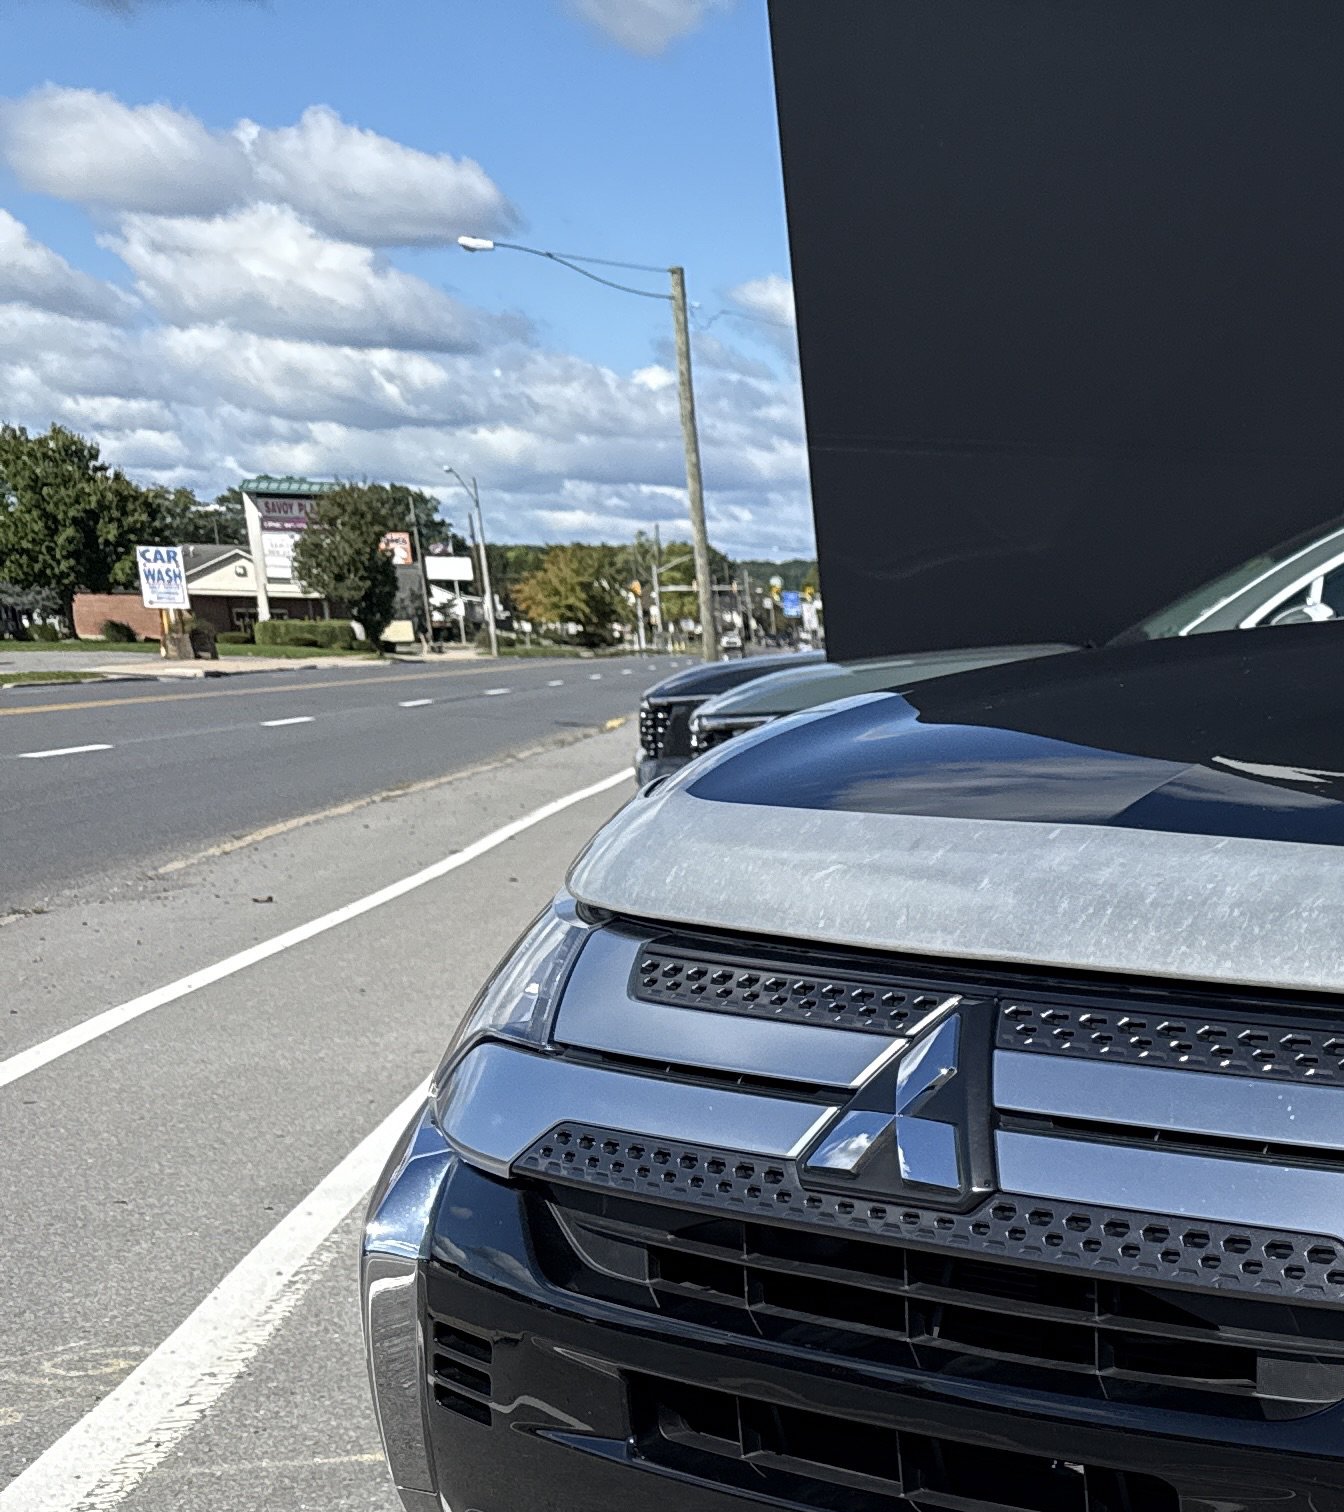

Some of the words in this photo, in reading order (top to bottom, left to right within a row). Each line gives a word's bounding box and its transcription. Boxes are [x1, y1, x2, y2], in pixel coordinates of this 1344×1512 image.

[263, 500, 294, 515] SAVOY
[139, 548, 179, 566] CAR
[143, 567, 183, 584] WASH
